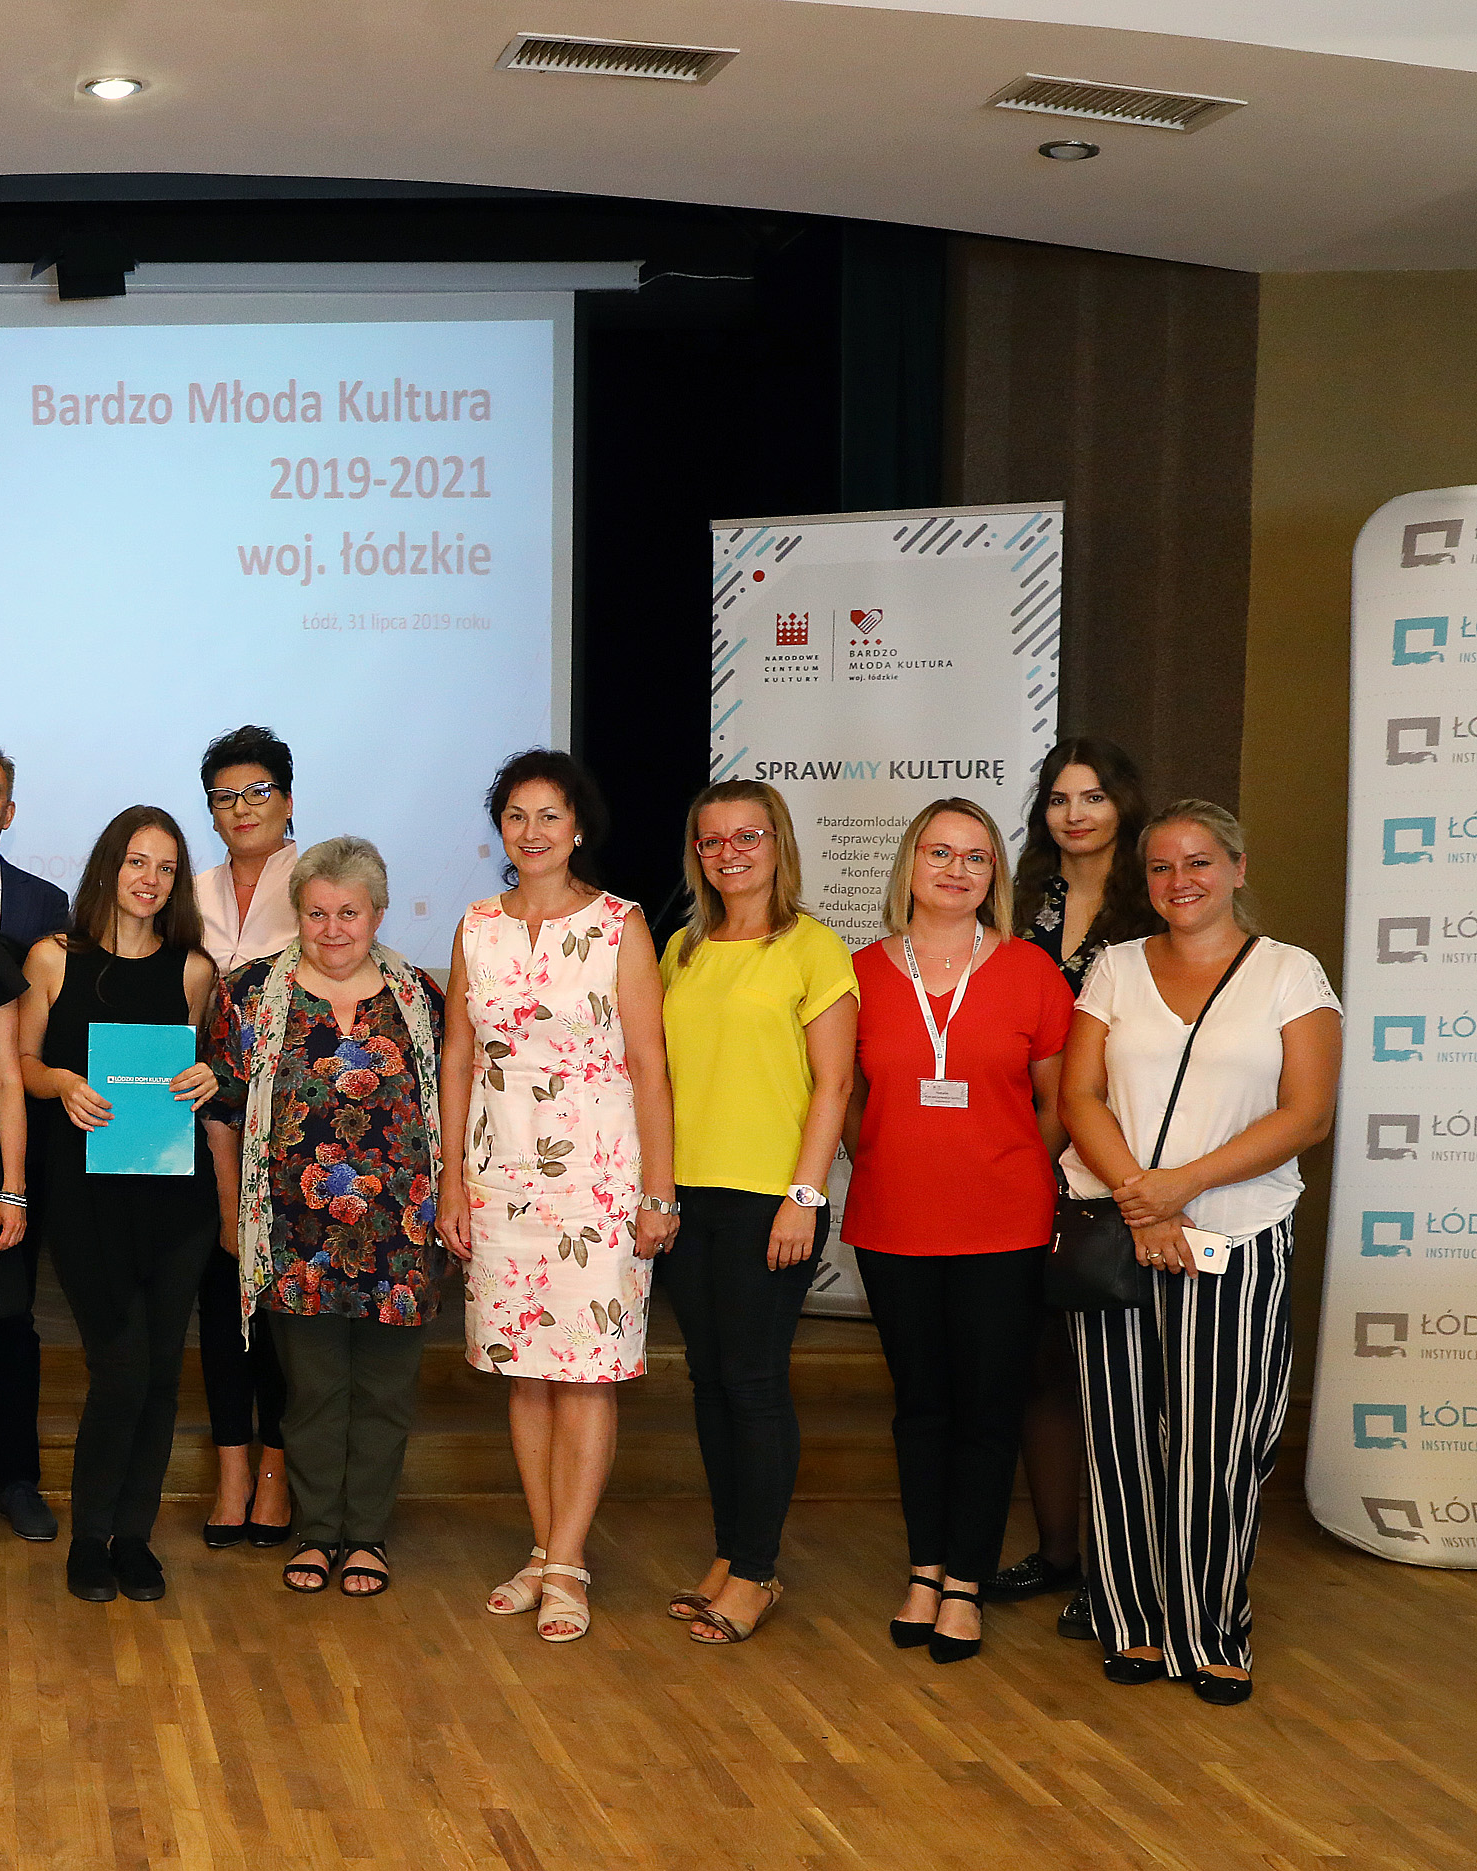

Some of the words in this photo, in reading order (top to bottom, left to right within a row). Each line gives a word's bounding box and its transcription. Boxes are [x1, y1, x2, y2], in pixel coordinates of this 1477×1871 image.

[31, 380, 173, 426] Bardzo
[187, 378, 322, 424] Młoda
[338, 377, 492, 422] Kultura
[269, 456, 492, 500] 2019-2021
[237, 533, 326, 587] woj.
[340, 531, 492, 576] łódzkie
[302, 612, 342, 632] Łódź,
[348, 613, 365, 630] 31
[372, 612, 407, 633] lipca
[412, 613, 451, 630] 2019
[455, 614, 491, 630] roku
[849, 648, 898, 658] BARDZO
[849, 661, 891, 670] MŁODA
[897, 659, 953, 669] KULTURA
[755, 761, 881, 780] SPRAWMY
[889, 760, 1006, 785] KULTURĘ
[821, 849, 870, 861] #lodzkie
[823, 883, 882, 897] #diagnoza
